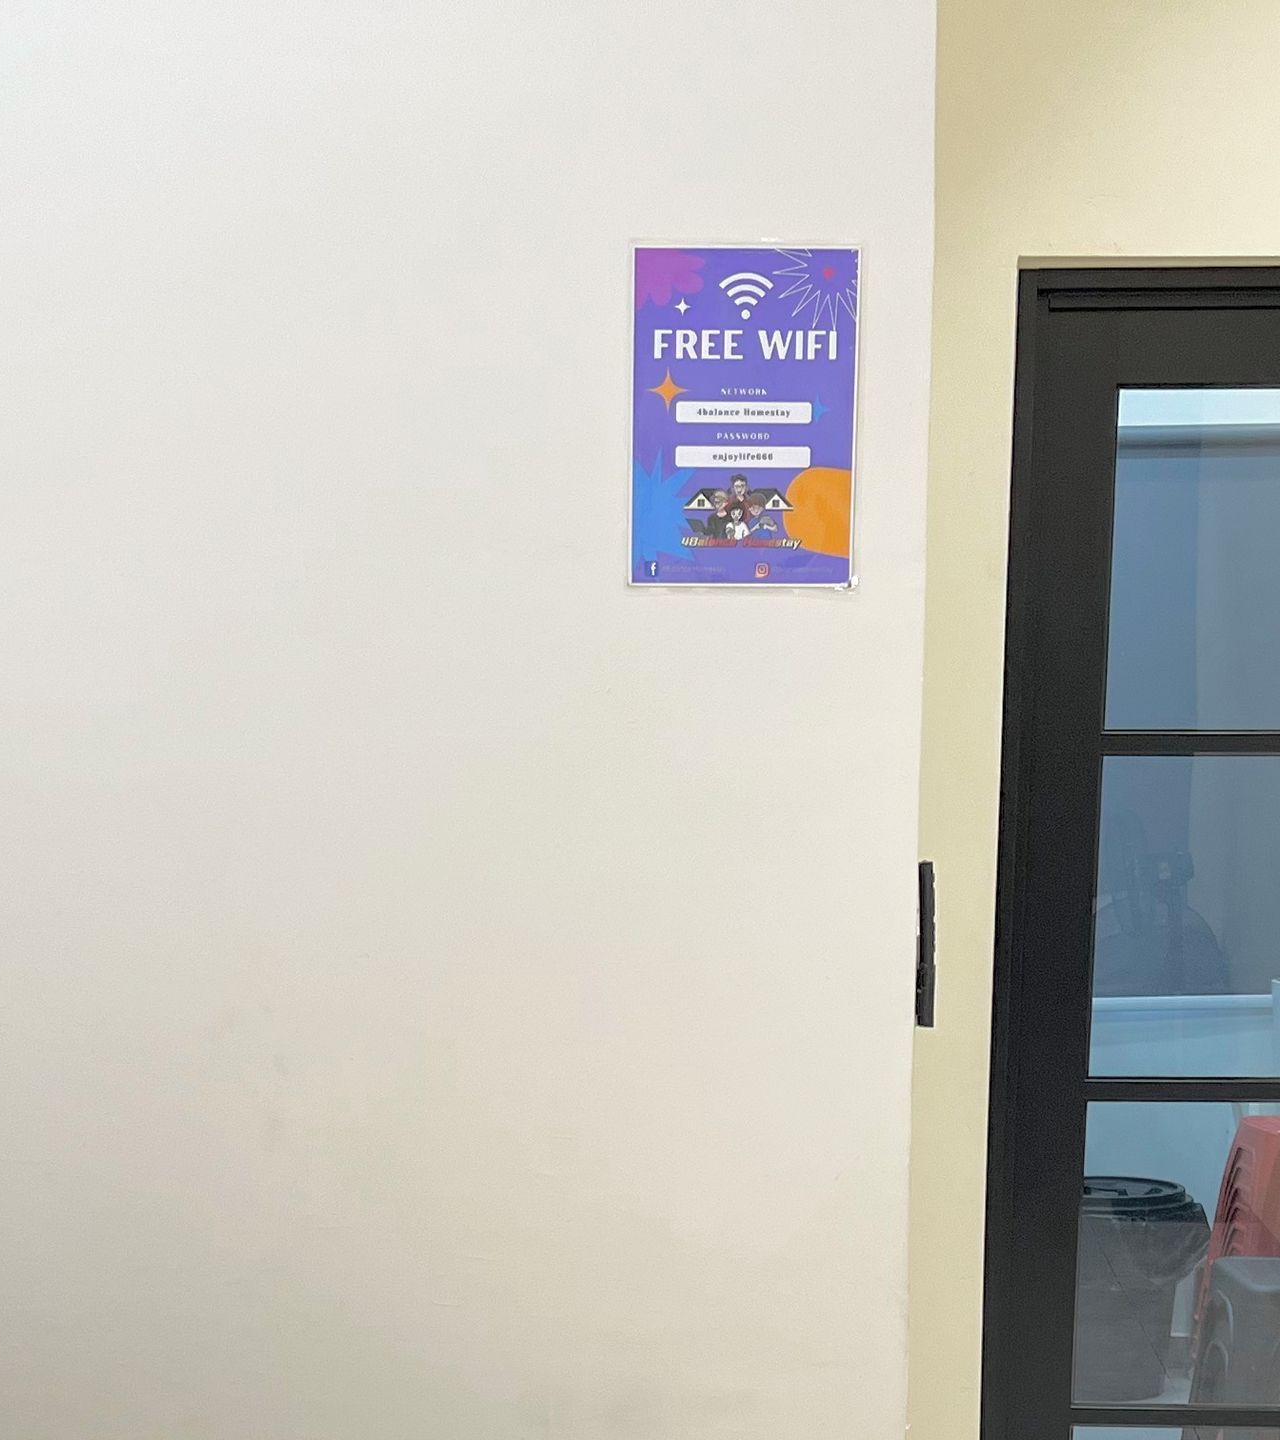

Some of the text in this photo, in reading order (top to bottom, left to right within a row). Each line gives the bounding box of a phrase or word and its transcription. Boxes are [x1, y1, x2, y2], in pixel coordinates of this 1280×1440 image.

[653, 329, 838, 360] FREE WIFI
[720, 387, 768, 396] NETWORK
[696, 407, 791, 418] 4balance Homestay
[716, 432, 770, 440] PASSWORD
[712, 452, 774, 462] enjoylife666
